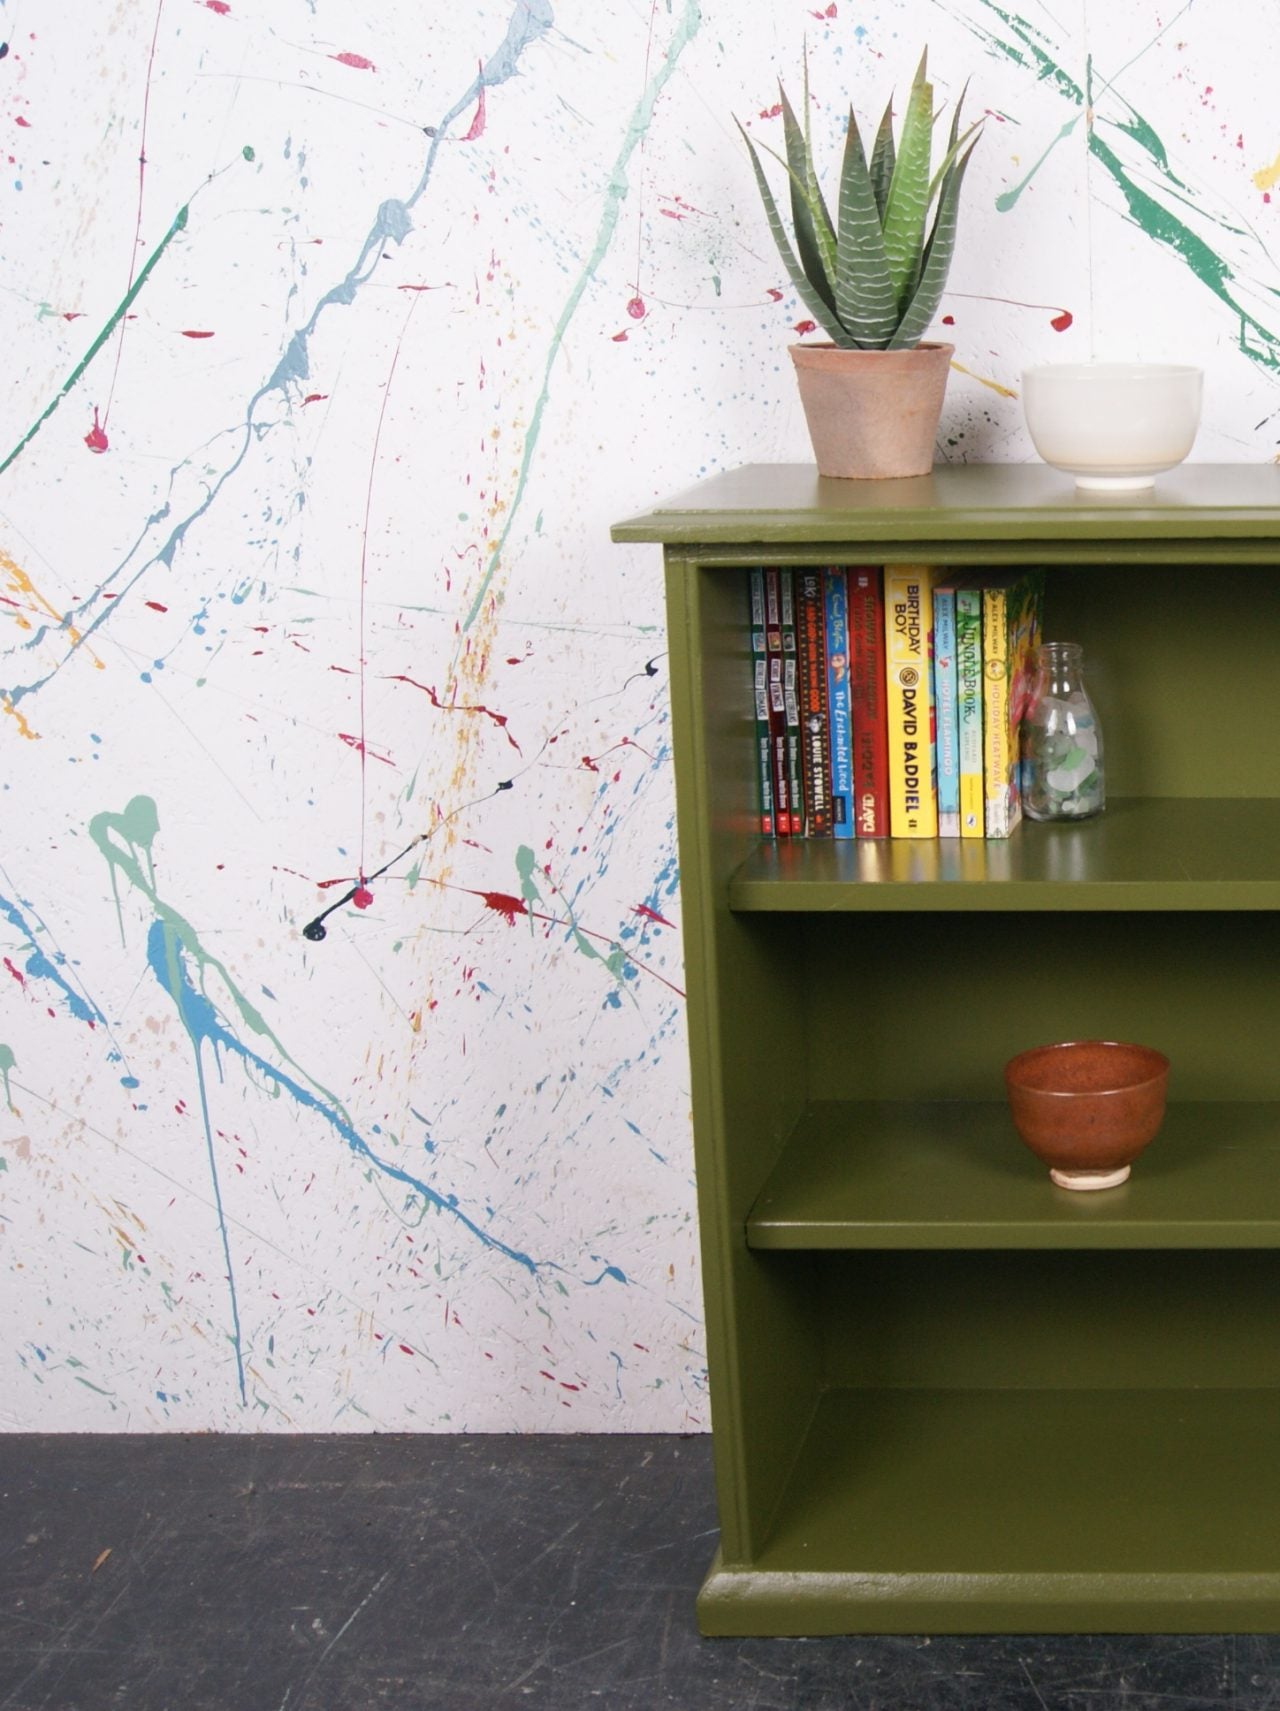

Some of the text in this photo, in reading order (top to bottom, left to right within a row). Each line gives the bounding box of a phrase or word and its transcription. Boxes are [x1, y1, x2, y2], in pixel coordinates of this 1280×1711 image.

[895, 604, 906, 636] BOY
[907, 585, 920, 654] BIRTHDAY
[962, 623, 976, 677] JUNGLE
[964, 679, 976, 724] BOOK
[902, 689, 919, 813] DAVID BADDIEL
[943, 717, 952, 776] FLAMINGO
[992, 684, 1001, 788] HOLIDAY HEATWAVE
[812, 735, 824, 811] LOUIE STOWELL
[862, 794, 875, 832] DAVID
